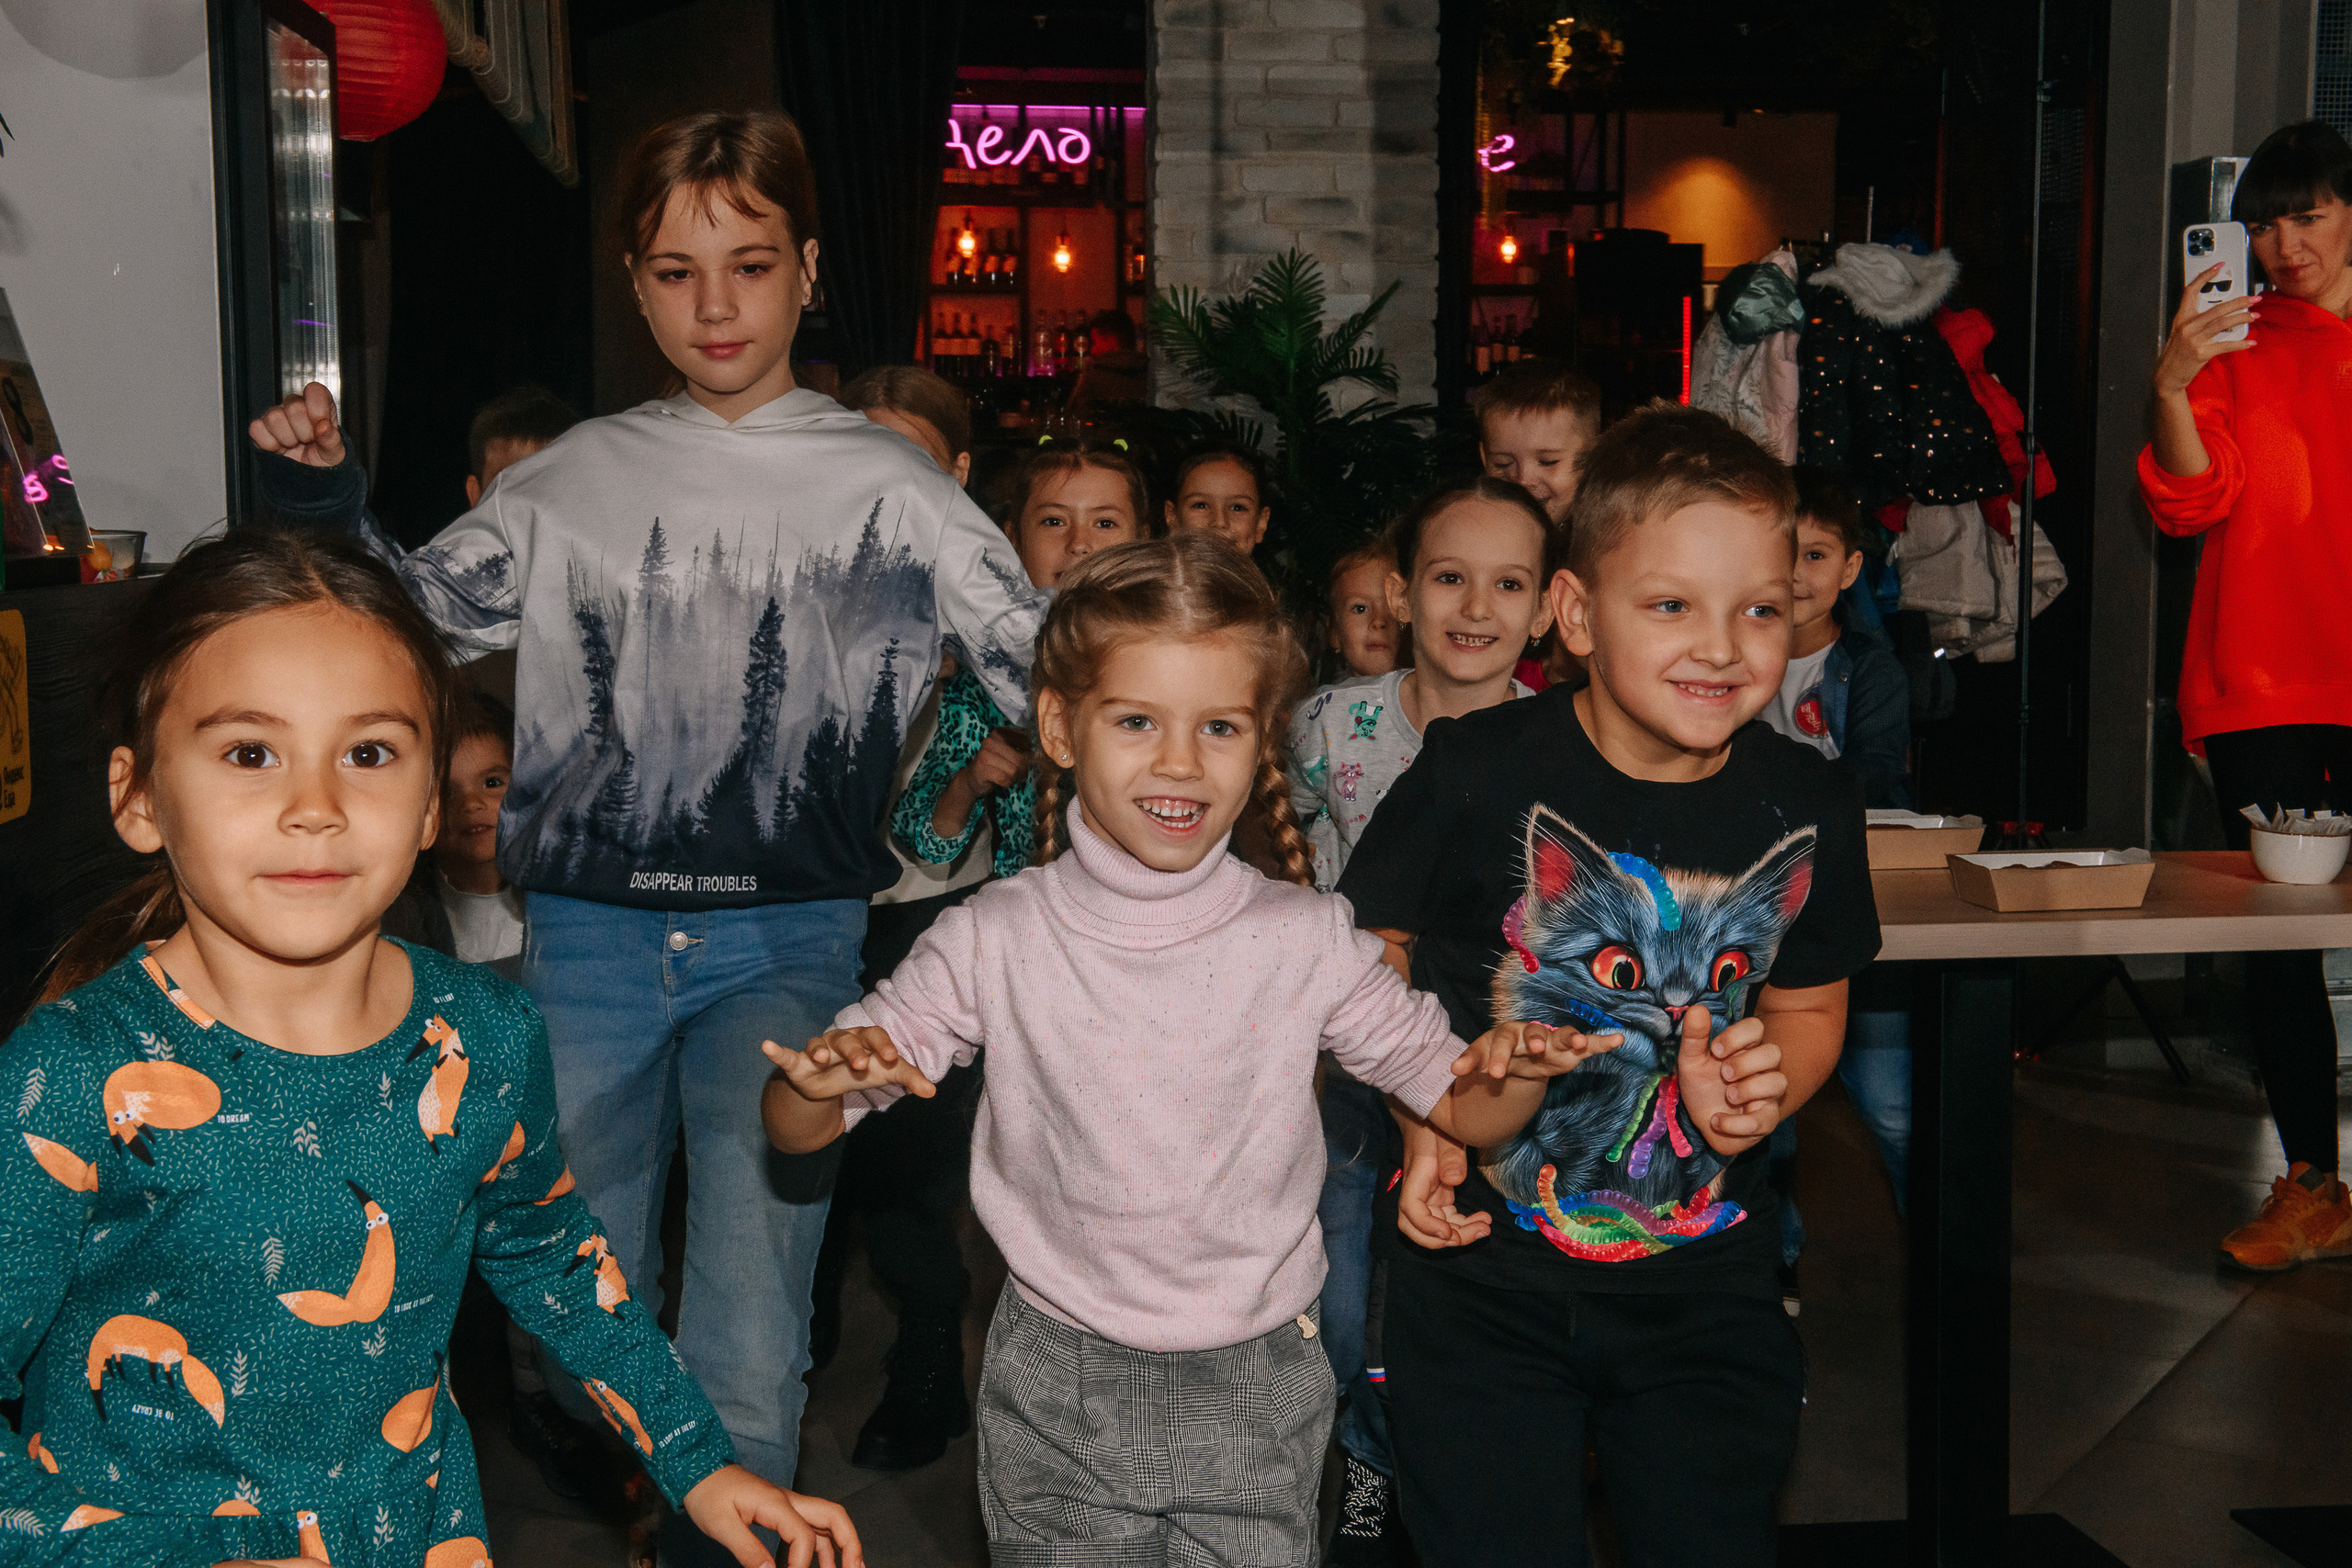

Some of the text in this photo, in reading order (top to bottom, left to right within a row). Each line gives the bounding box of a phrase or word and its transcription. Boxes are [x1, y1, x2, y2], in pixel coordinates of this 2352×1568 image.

[629, 871, 757, 892] DISAPPEAR TROUBLES
[218, 1113, 250, 1123] TO DREAM
[131, 1404, 175, 1421] TO BE CRAZY
